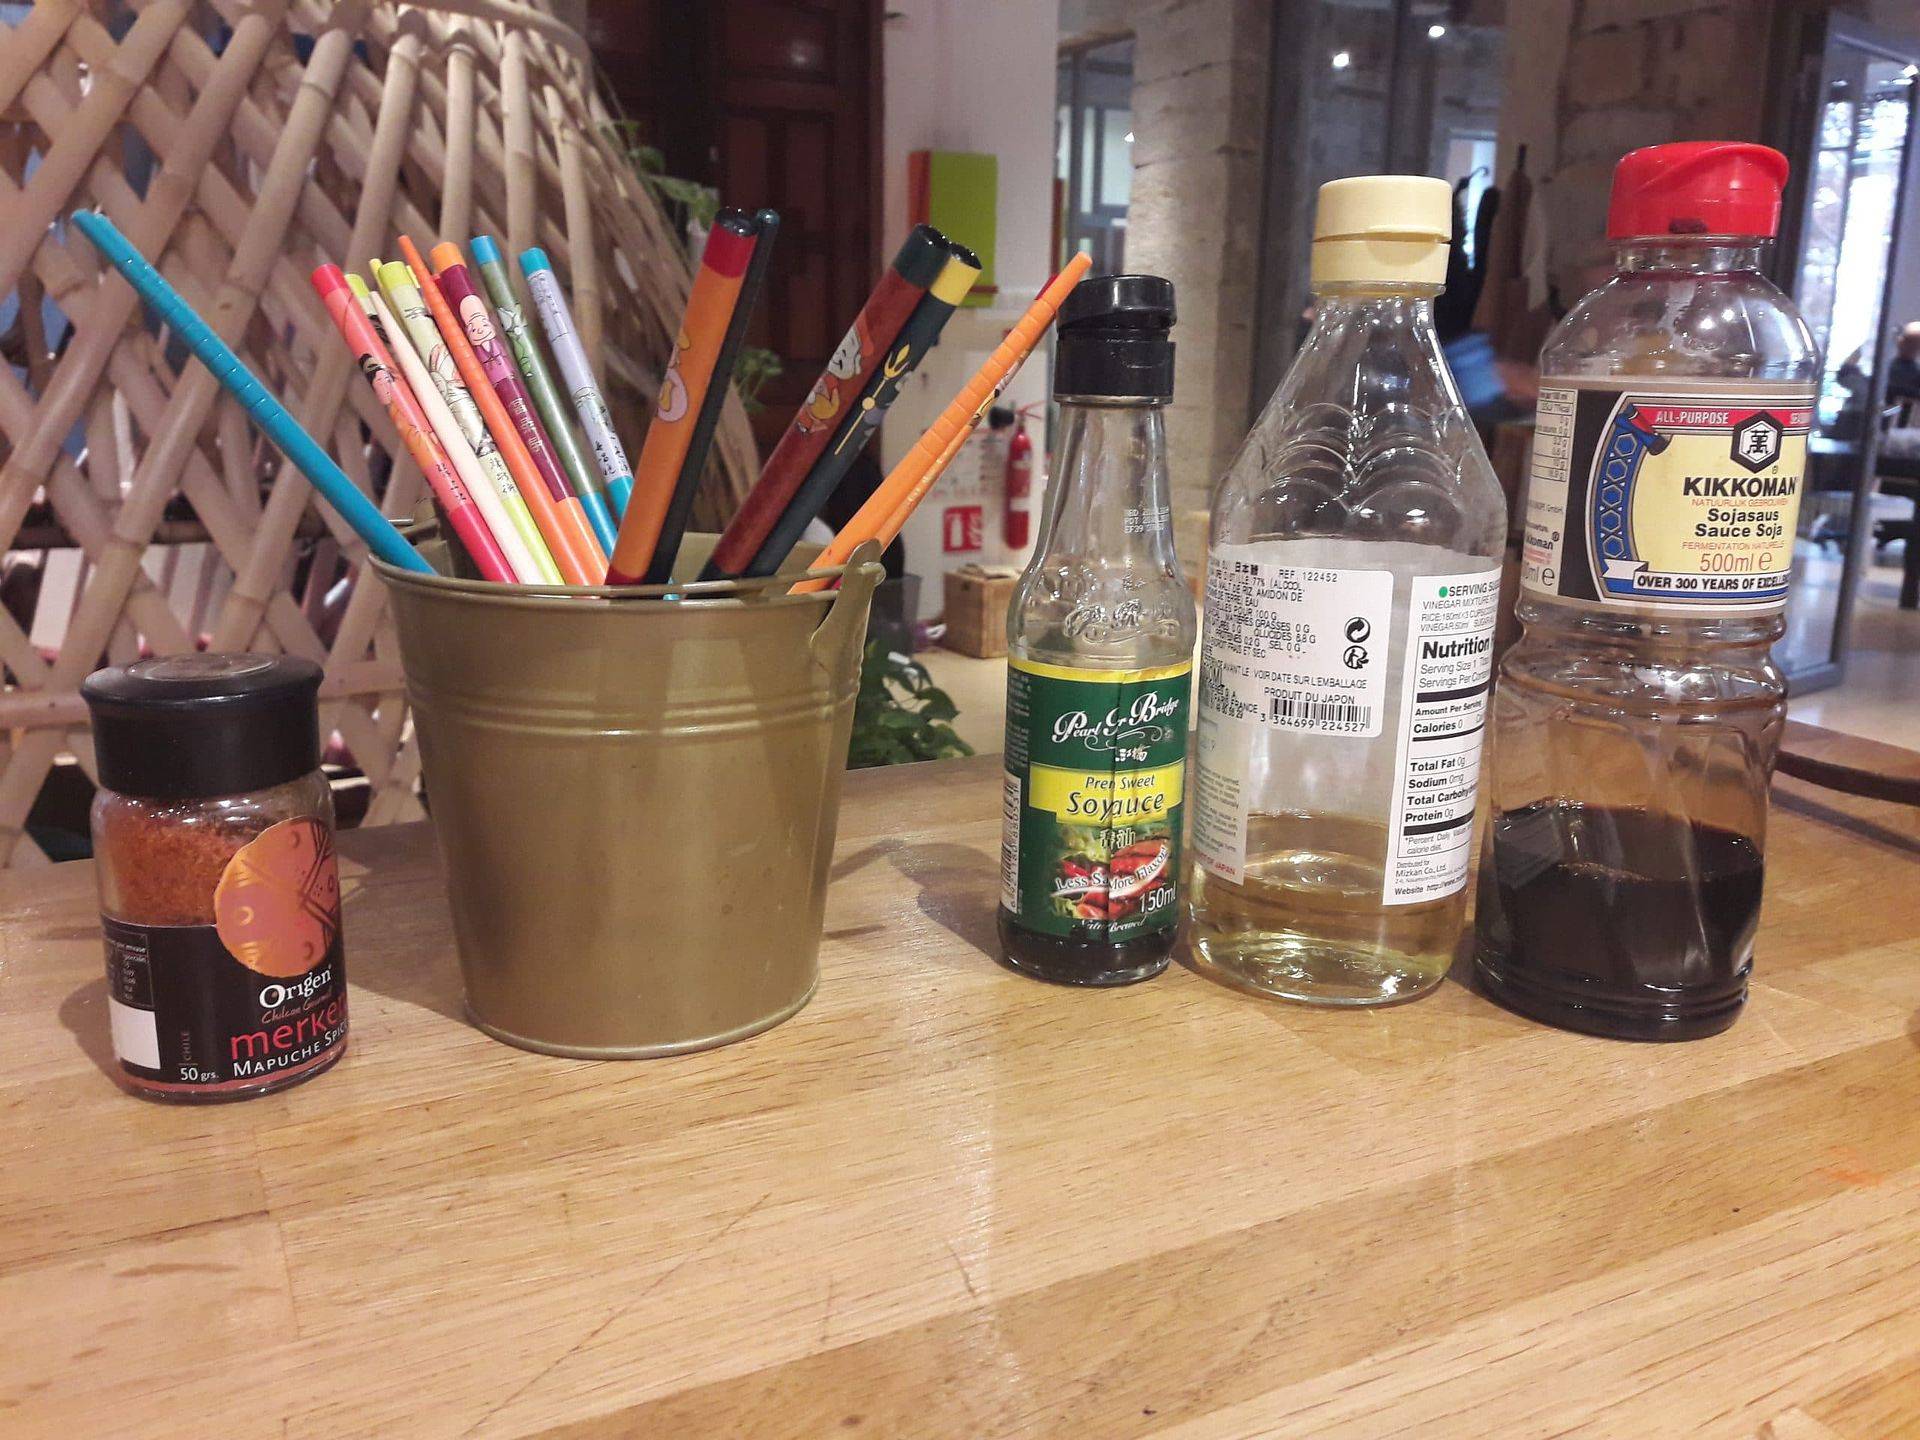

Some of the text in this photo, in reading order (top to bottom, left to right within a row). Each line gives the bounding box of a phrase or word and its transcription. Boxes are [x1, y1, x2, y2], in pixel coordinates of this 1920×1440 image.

[1655, 411, 1729, 425] ALL-PURPOSE
[1683, 477, 1796, 497] KIKKOMAN
[1707, 508, 1779, 525] Sojasaus
[1695, 523, 1783, 539] Sauce Soja
[1682, 541, 1750, 550] FERMENTATION
[1700, 553, 1754, 572] 500ml
[1303, 571, 1338, 583] 122452
[1637, 576, 1671, 588] OVER
[1675, 578, 1698, 590] 300
[1702, 578, 1739, 590] YEARS
[1742, 578, 1755, 589] OF
[1257, 590, 1288, 601] AMIDON
[1290, 592, 1303, 602] DE
[1449, 583, 1488, 597] SERVING
[1423, 599, 1460, 610] VINEGAR
[1256, 609, 1269, 620] 100
[1271, 612, 1277, 620] G
[1255, 618, 1291, 632] GRASSES
[1303, 624, 1310, 634] G
[1253, 647, 1266, 658] SEC
[1269, 640, 1284, 651] SEL
[1423, 636, 1490, 660] Nutrition
[1420, 663, 1455, 675] Serving
[1456, 660, 1472, 672] Size
[1271, 672, 1292, 683] DATE
[1293, 674, 1311, 685] SUR
[1418, 676, 1458, 689] Servings
[1459, 673, 1472, 684] Per
[1264, 686, 1355, 705] PRODUIT DU JAPON
[1051, 710, 1102, 743] Pearl
[1128, 690, 1180, 726] Bridge
[1415, 706, 1449, 716] Amount
[1449, 704, 1463, 714] Per
[1260, 713, 1366, 732] 3 364699 224527
[1413, 721, 1457, 734] Calories
[1410, 760, 1439, 772] Total
[1441, 758, 1456, 769] Fat
[1120, 774, 1155, 789] Sweet
[1408, 777, 1447, 789] Sodium
[1407, 794, 1436, 806] Total
[1404, 810, 1443, 823] Protein
[1395, 868, 1424, 878] Mizkan
[1055, 874, 1089, 891] Less
[1140, 880, 1177, 914] 150ml
[1394, 885, 1424, 896] Website
[259, 969, 332, 1008] Origen
[233, 1041, 321, 1077] MAPUCHE
[180, 1067, 199, 1081] 50
